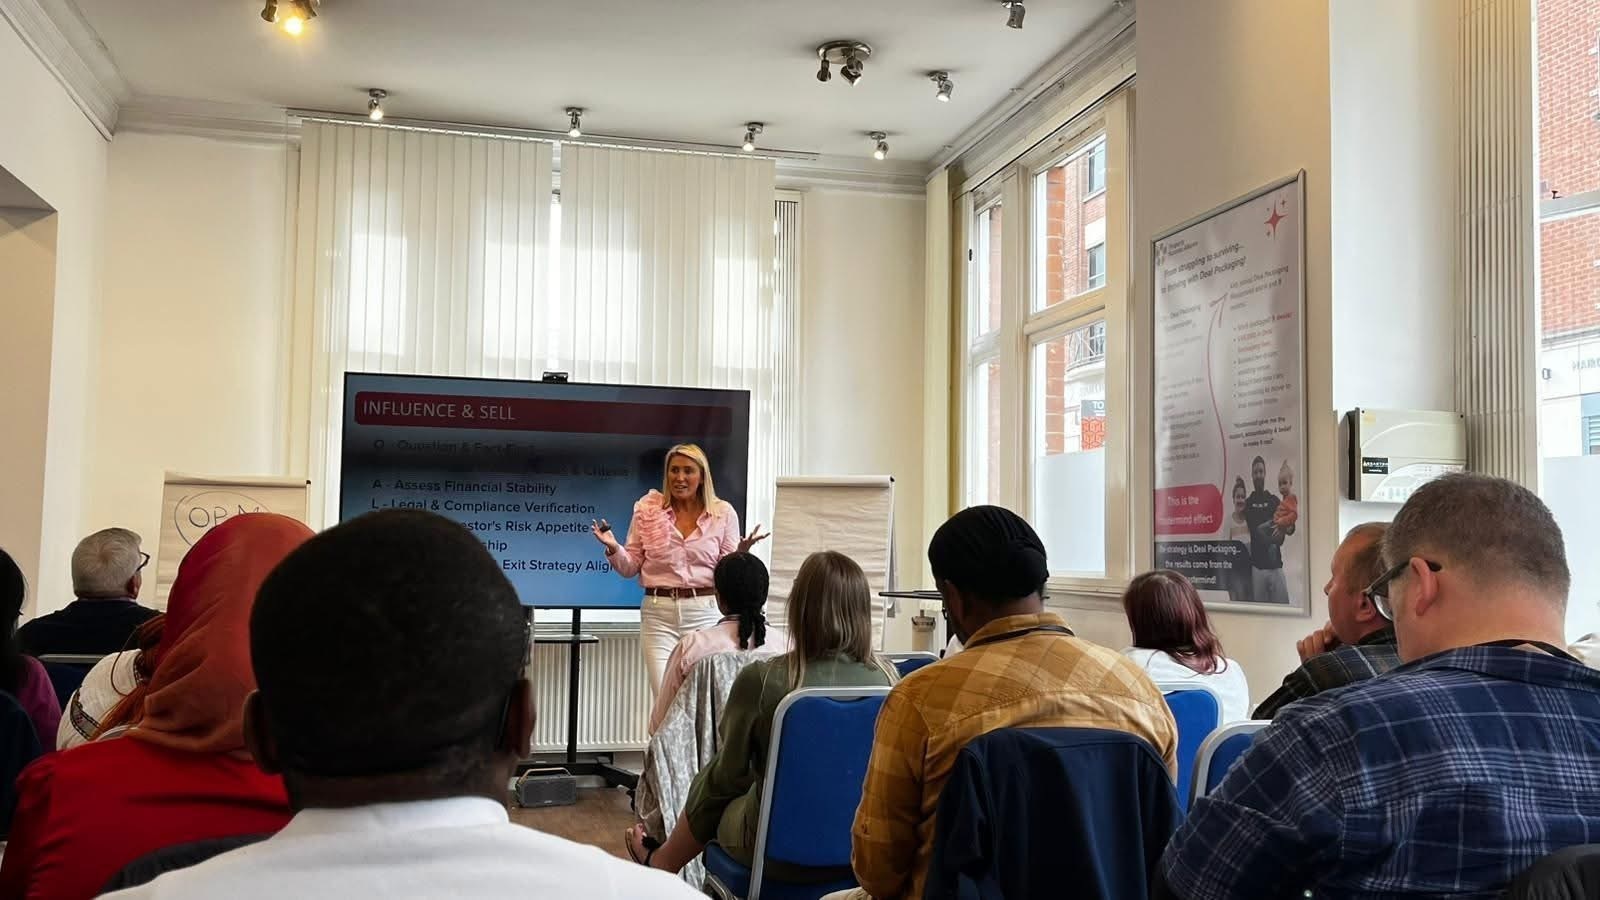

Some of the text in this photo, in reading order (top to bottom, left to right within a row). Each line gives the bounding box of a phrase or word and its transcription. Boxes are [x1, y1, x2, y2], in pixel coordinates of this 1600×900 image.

[1178, 256, 1206, 274] struggling
[1199, 267, 1213, 280] Deal
[363, 400, 516, 420] INFLUENCE & SELL
[371, 479, 382, 489] A
[394, 479, 441, 491] Assess
[445, 480, 502, 493] Financial
[506, 482, 557, 496] Stability
[371, 498, 379, 509] L
[430, 500, 440, 511] &
[444, 500, 520, 514] Compliance
[524, 502, 595, 514] Verification
[1188, 495, 1200, 505] the
[1193, 513, 1213, 525] effect
[461, 520, 590, 536] estor's Risk Appetite
[1193, 544, 1207, 553] Deal
[503, 559, 526, 570] Exit
[529, 559, 582, 574] Strategy
[1165, 560, 1233, 569] the results come from the
